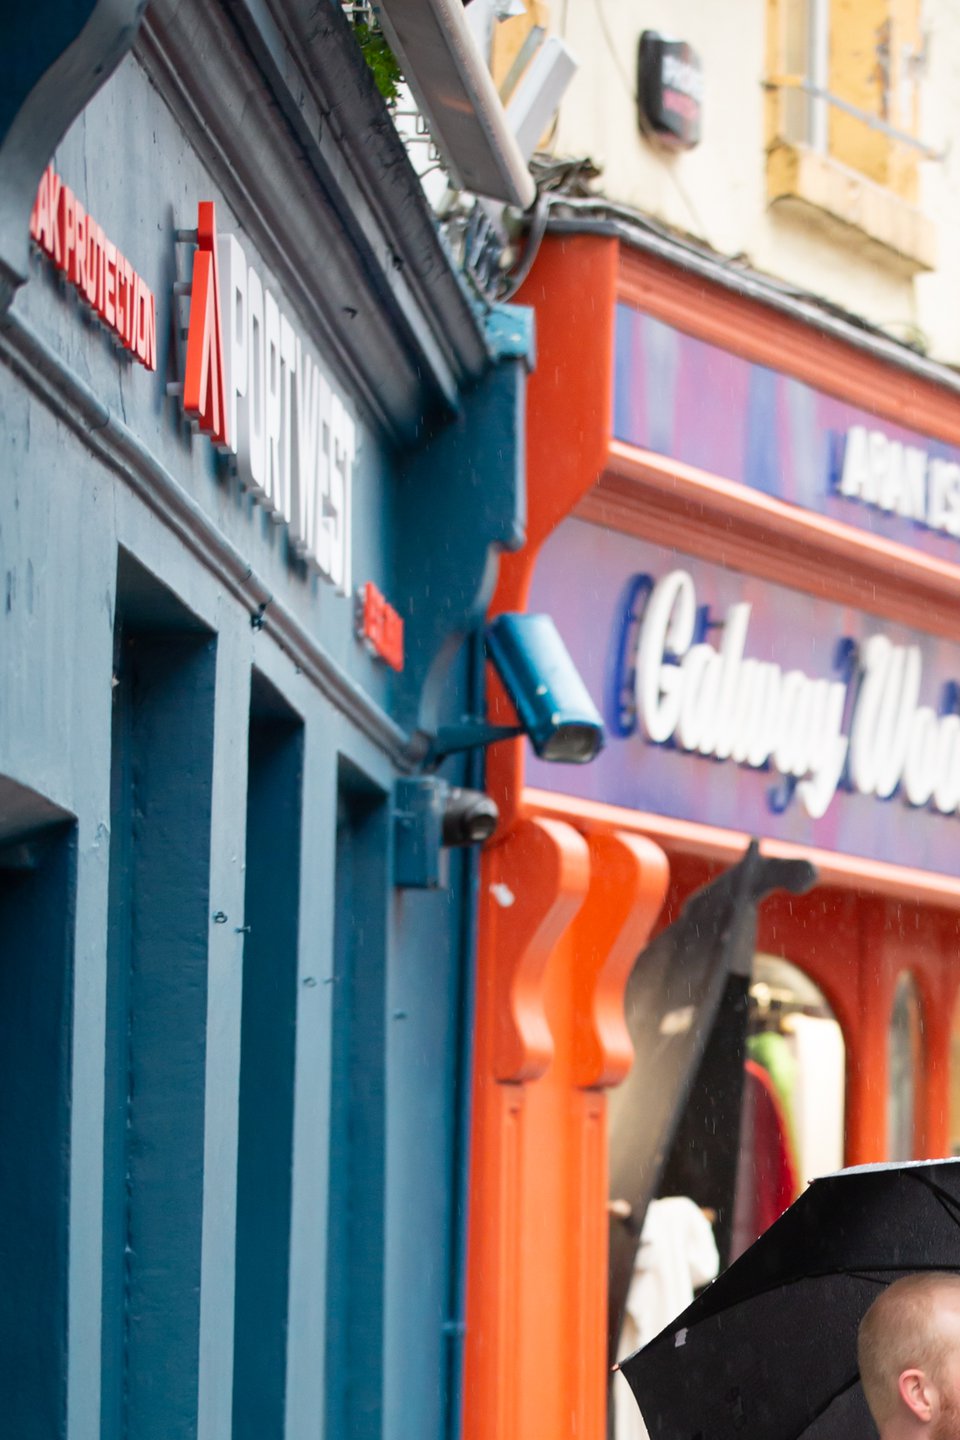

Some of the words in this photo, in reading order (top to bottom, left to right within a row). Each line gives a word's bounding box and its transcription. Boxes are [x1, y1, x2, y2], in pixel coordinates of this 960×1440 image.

[30, 160, 62, 268] AK
[60, 182, 157, 372] PROTECTION
[219, 233, 356, 599] PORTWEST
[635, 568, 848, 819] Galway
